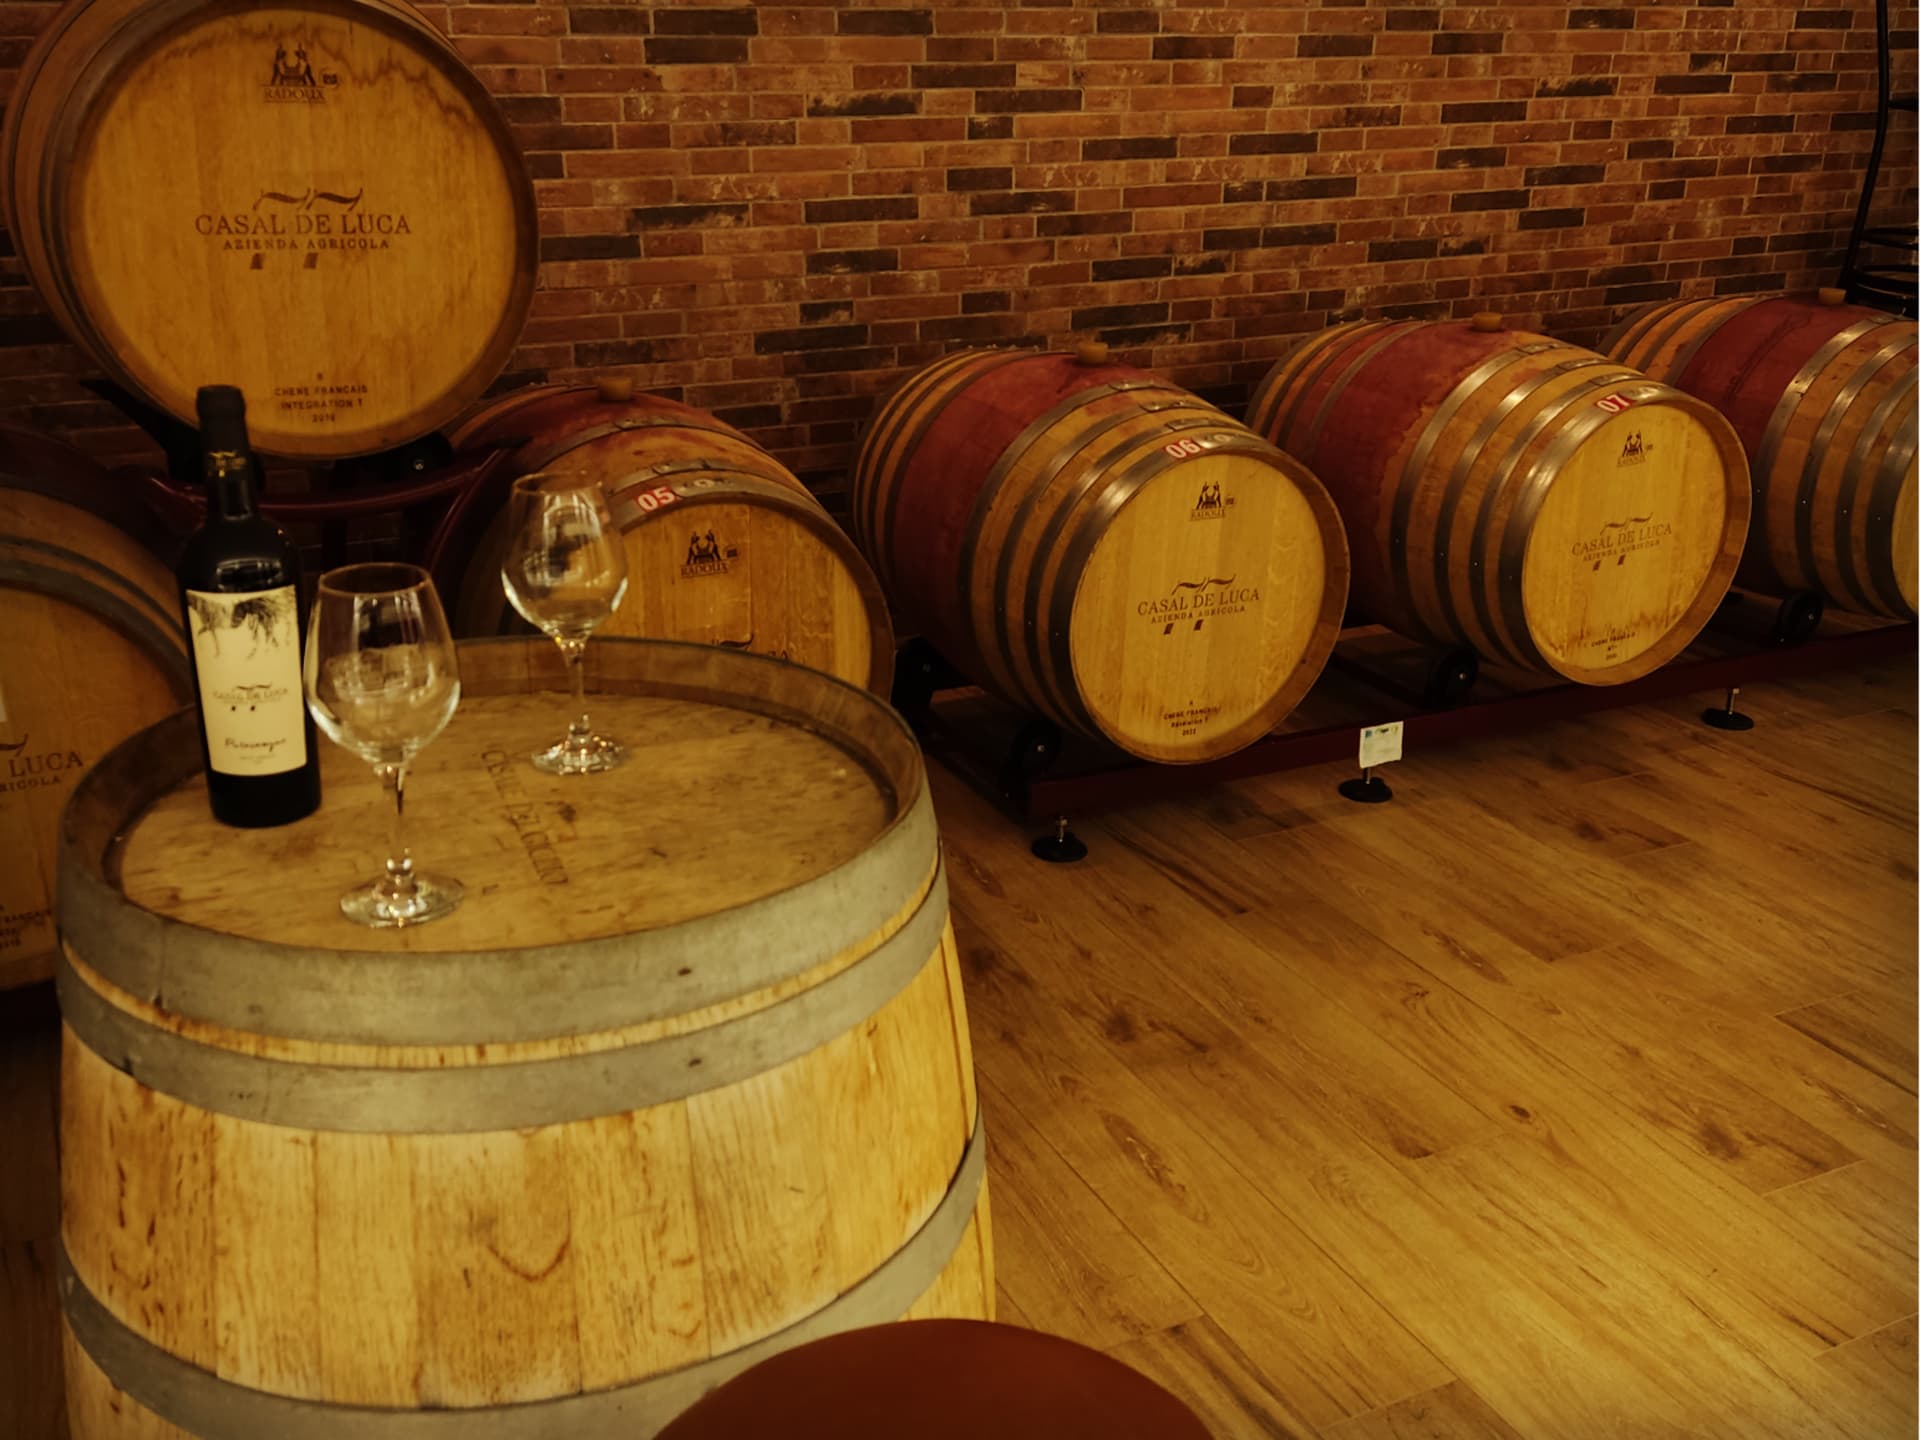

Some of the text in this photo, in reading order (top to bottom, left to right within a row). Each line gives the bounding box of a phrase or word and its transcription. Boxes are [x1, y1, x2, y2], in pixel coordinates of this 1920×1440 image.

[195, 215, 411, 235] CASAL DE LUCA
[224, 238, 390, 250] AZIENDA AGRICOLA
[1597, 394, 1630, 412] 07
[1166, 439, 1200, 458] 06
[637, 487, 675, 512] 05
[1571, 523, 1672, 556] CASAL DE LUCA
[1137, 588, 1260, 616] CASAL DE LUCA
[1151, 606, 1246, 624] AZIENDA AGRICOLA
[8, 751, 84, 777] LUCA
